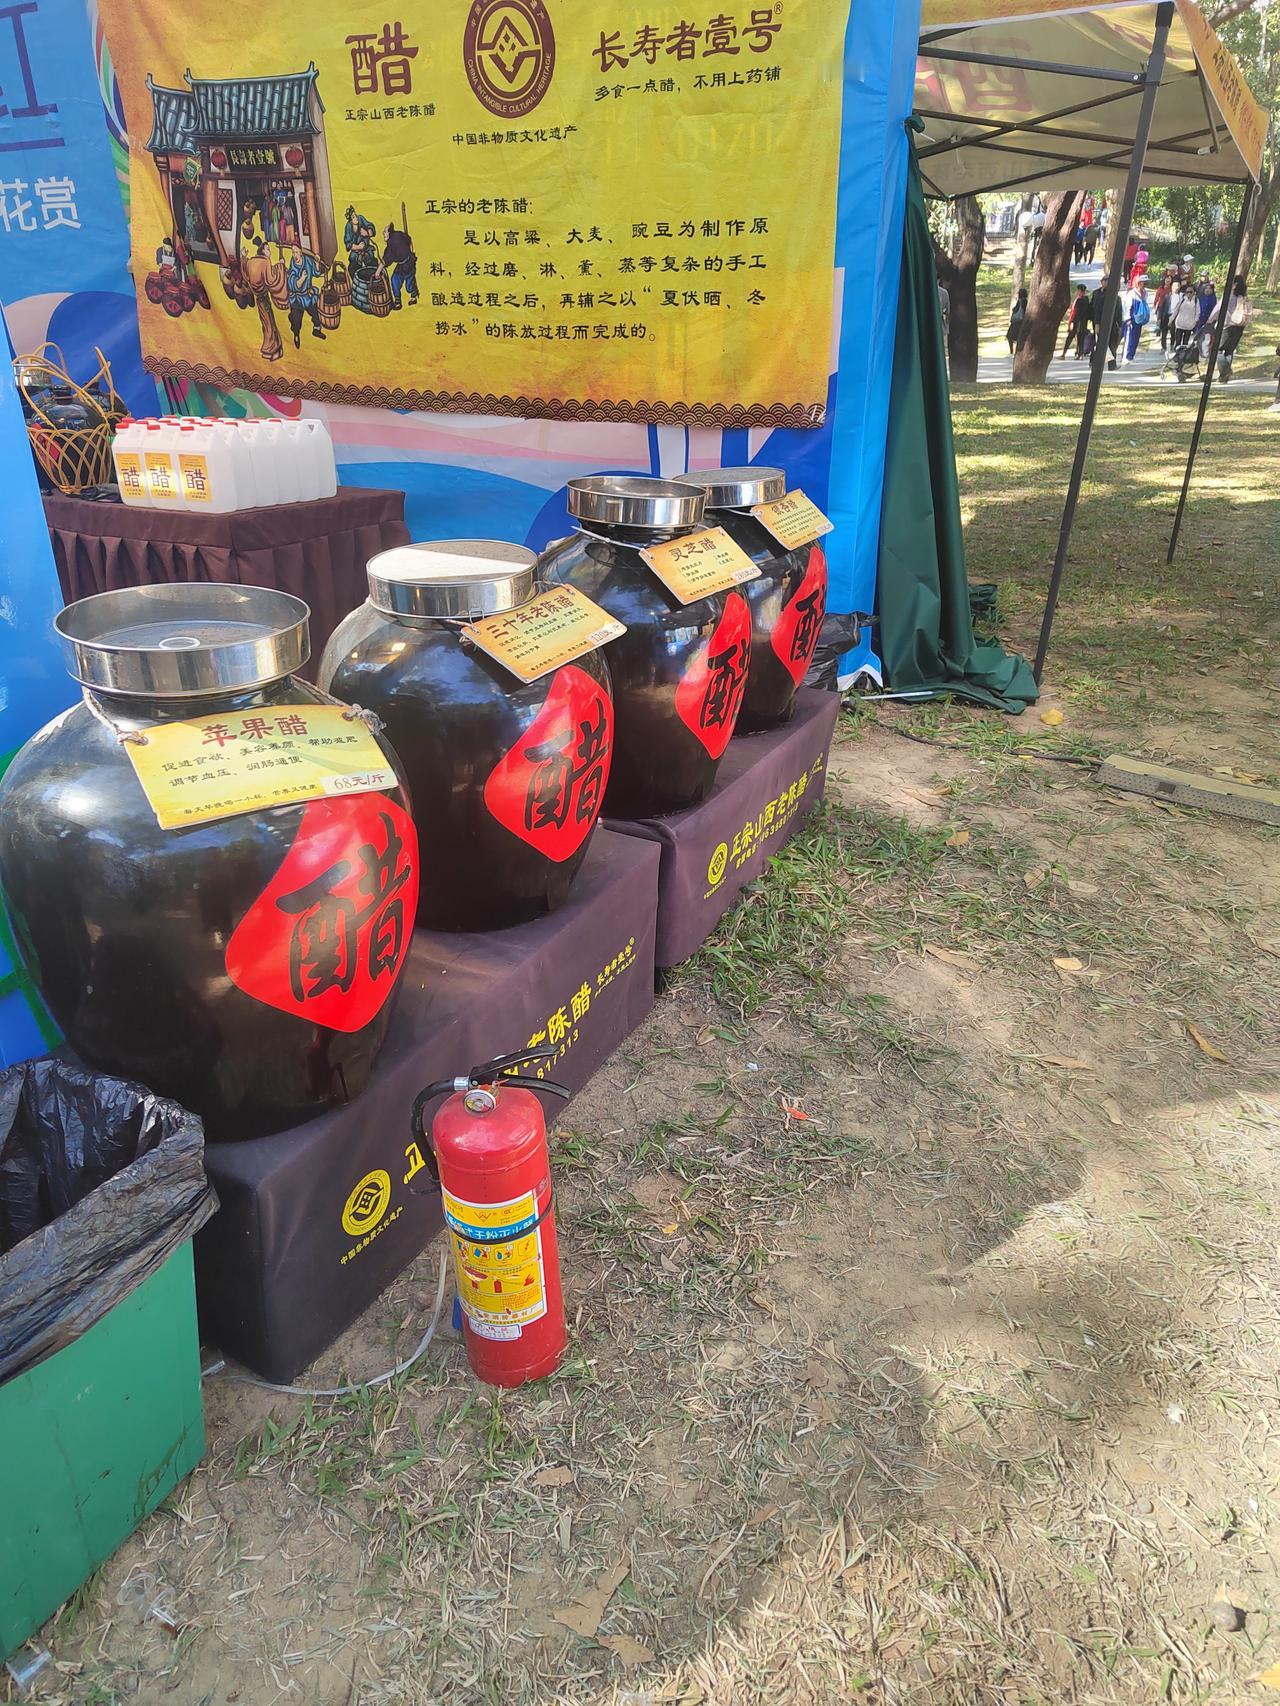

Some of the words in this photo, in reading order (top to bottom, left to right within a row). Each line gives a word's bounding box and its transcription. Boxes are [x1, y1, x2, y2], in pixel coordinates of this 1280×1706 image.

[345, 22, 420, 96] 醋
[344, 105, 437, 122] 正宗山西老陈醋
[452, 124, 578, 146] 中国非物质文化遗产
[0, 176, 82, 232] 花赏
[121, 466, 140, 488] 醋
[149, 466, 171, 489] 醋
[184, 468, 207, 491] 醋
[668, 537, 718, 562] 灵芝醋
[486, 594, 575, 639] 三十年老陈醋
[202, 714, 308, 748] 苹果醋
[523, 697, 609, 831] 醋
[333, 772, 386, 791] 68元/斤
[276, 811, 412, 1003] 醋
